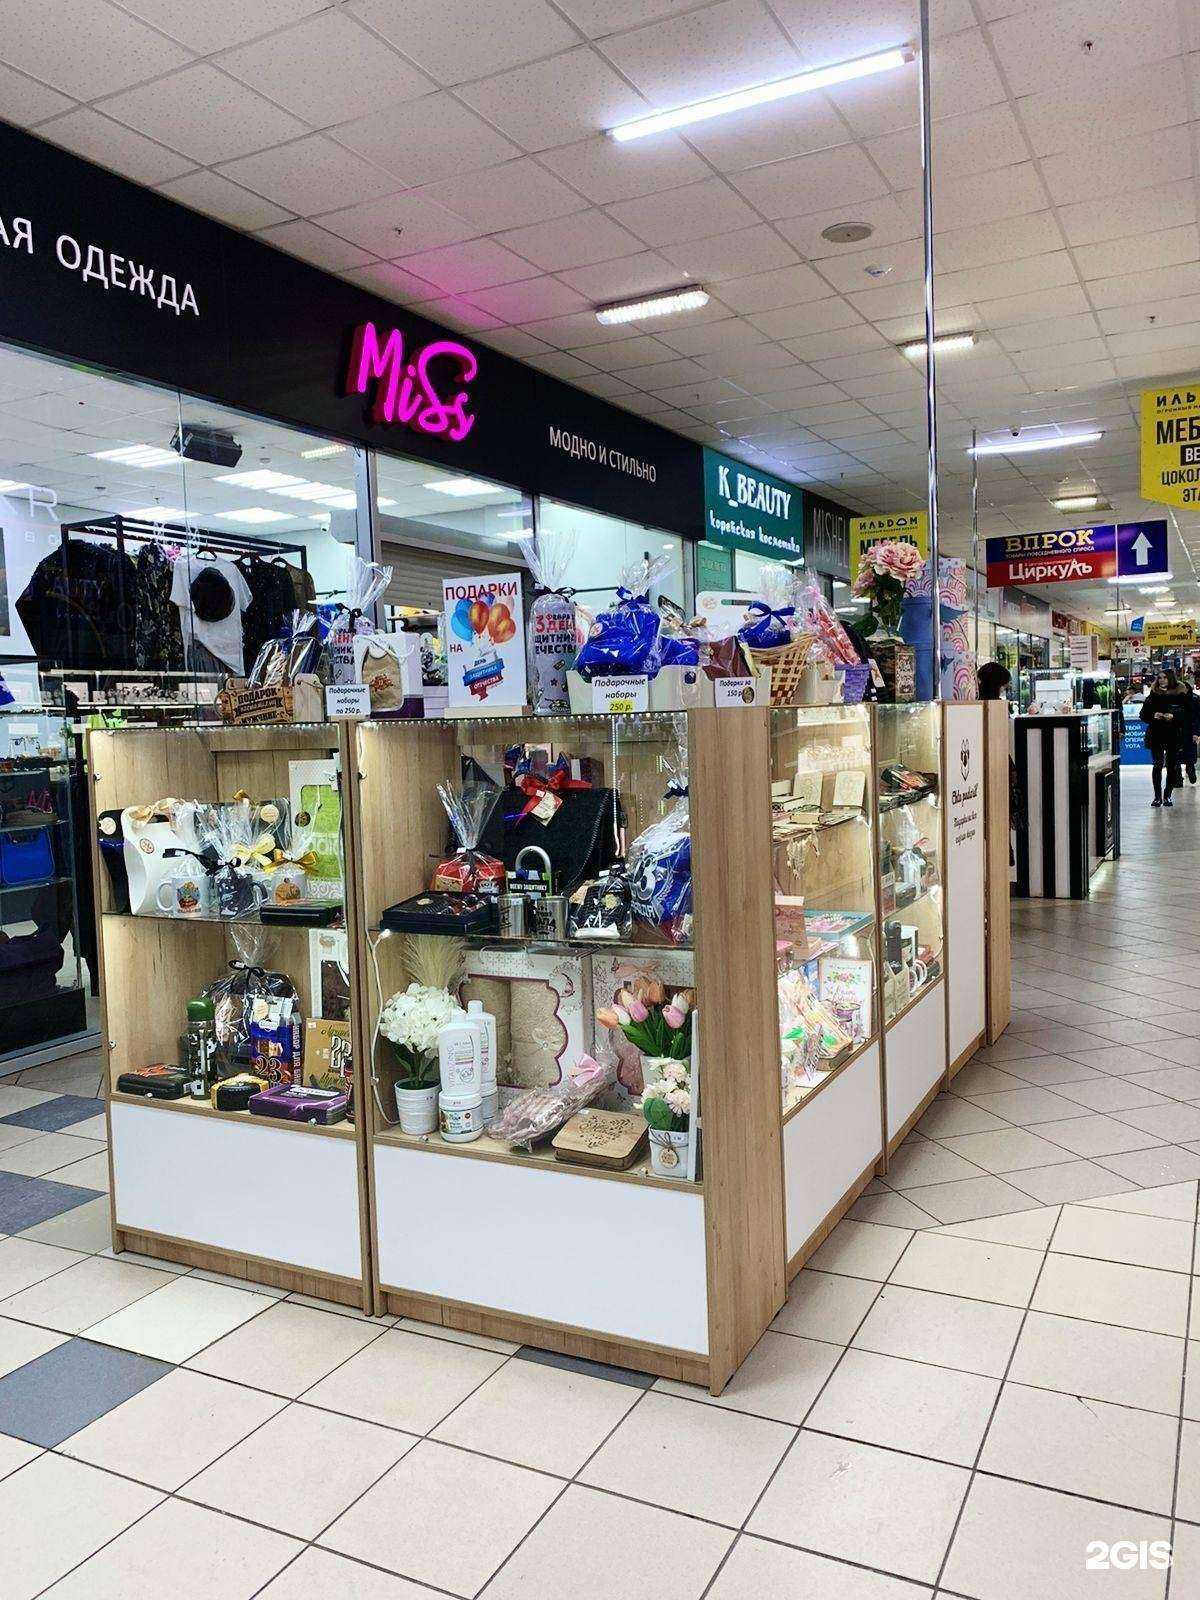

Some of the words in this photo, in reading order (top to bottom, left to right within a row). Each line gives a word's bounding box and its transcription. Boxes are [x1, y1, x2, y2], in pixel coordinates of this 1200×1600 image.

[56, 234, 200, 316] ОДЕЖДА
[1156, 416, 1200, 445] МЕБ
[549, 426, 597, 460] МОДНО
[599, 445, 607, 465] И
[609, 450, 657, 482] СТИЛЬНО
[1005, 529, 1095, 552] ВПРОК
[445, 581, 518, 600] ПОДАРКИ
[450, 644, 463, 653] НА
[595, 678, 646, 687] Подарочные
[605, 692, 637, 700] наборы
[610, 703, 624, 711] 250
